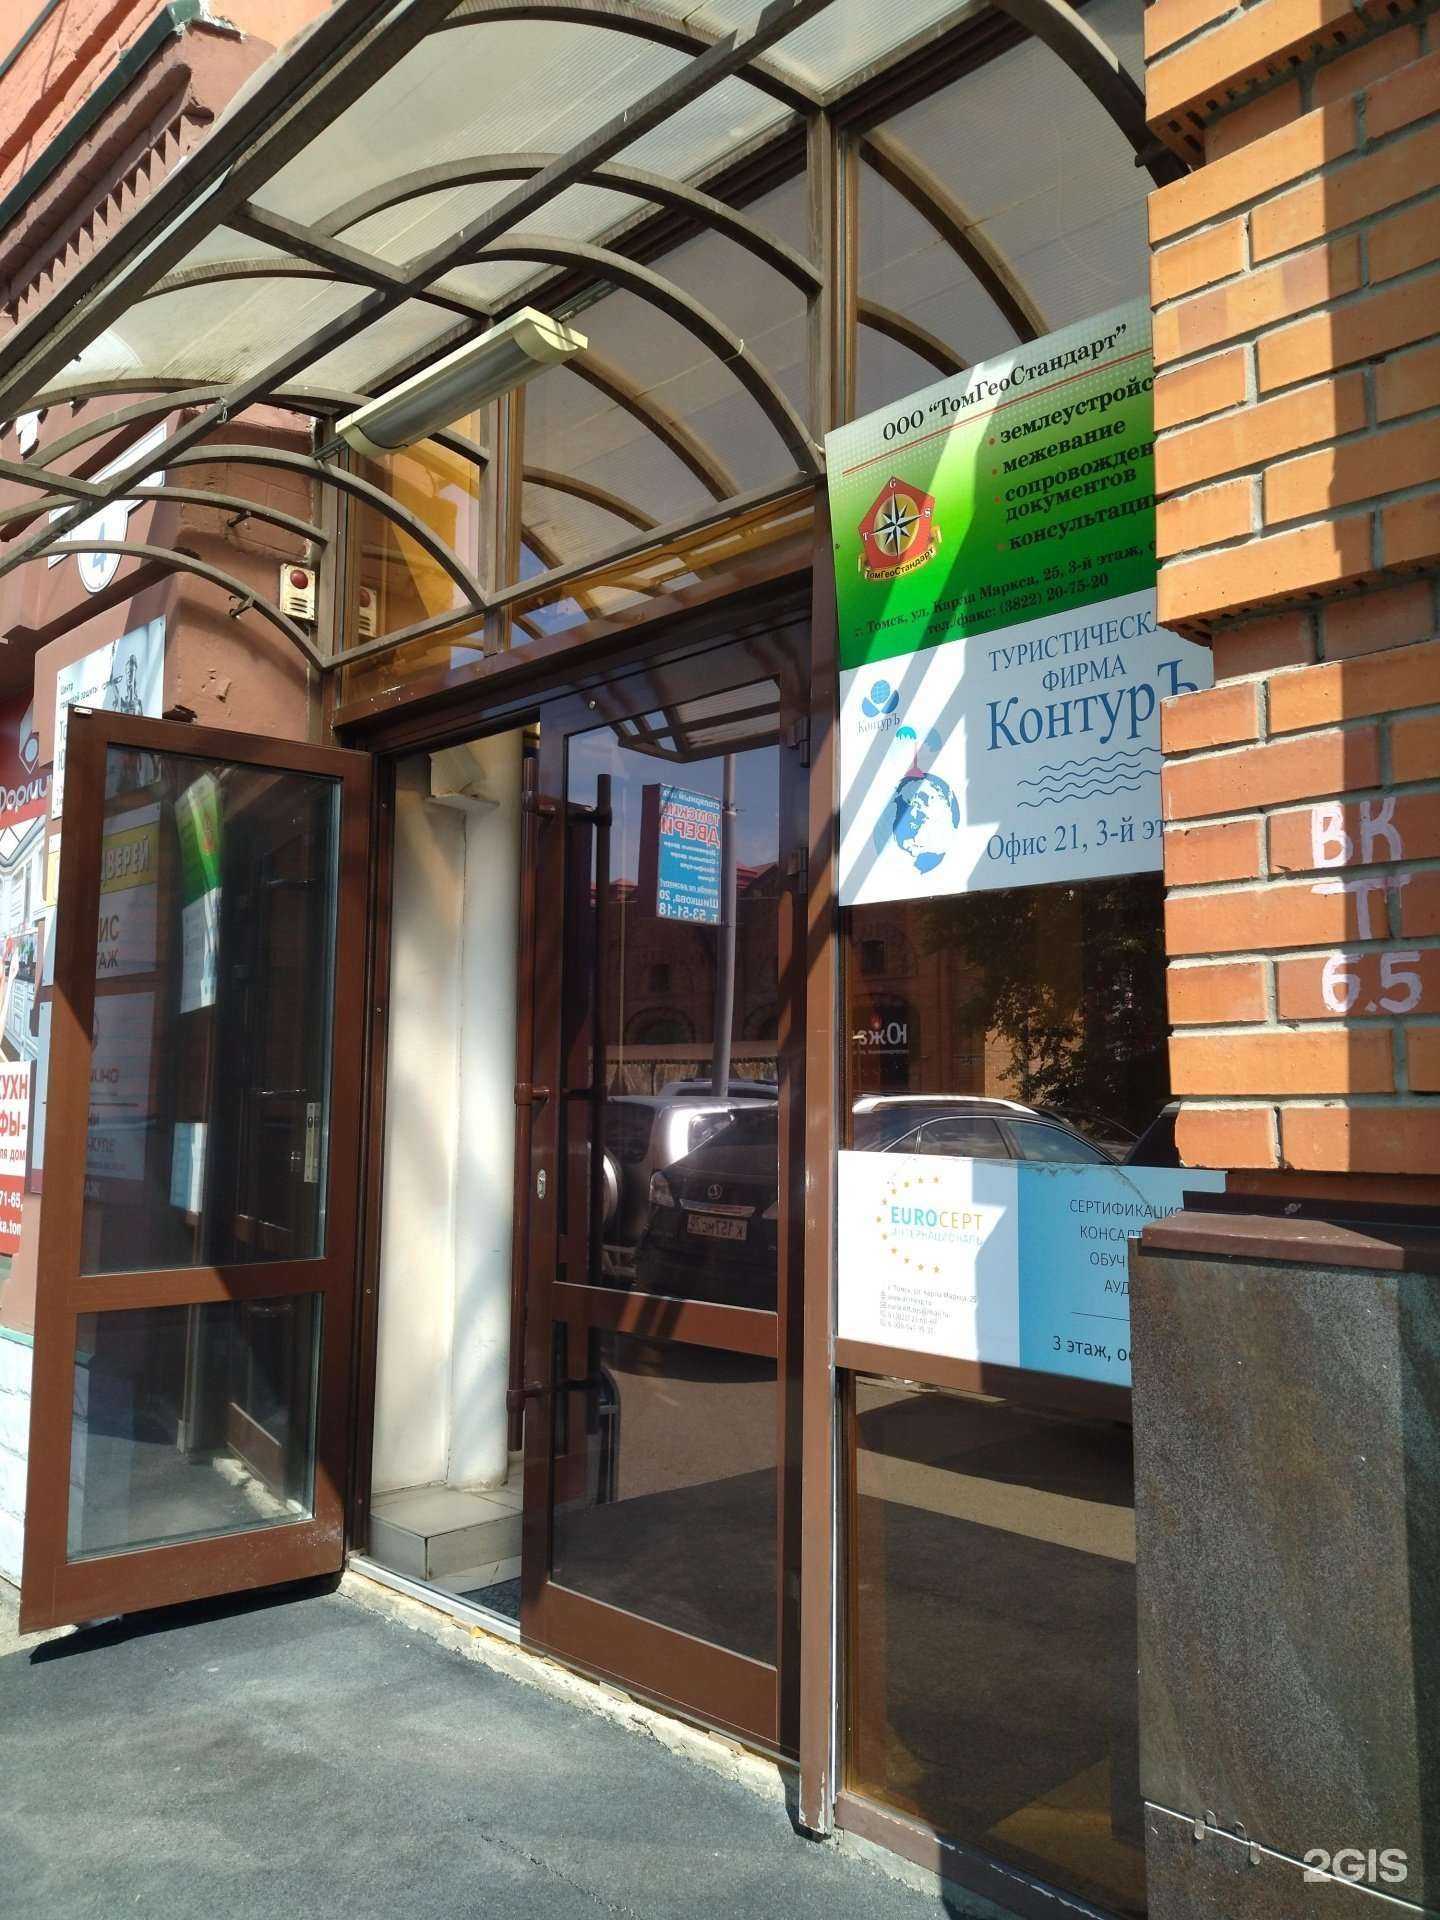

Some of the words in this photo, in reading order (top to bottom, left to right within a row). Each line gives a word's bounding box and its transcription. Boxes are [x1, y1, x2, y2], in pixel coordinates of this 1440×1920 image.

[883, 410, 925, 441] ООО
[1000, 375, 1156, 444] землеустройс
[1003, 420, 1127, 474] межевание
[1006, 468, 1137, 525] документов
[1047, 573, 1109, 602] 20-75-20
[988, 611, 1157, 672] ТУРИСТИЧЕСК
[1042, 653, 1128, 692] ФИРМА
[987, 831, 1048, 864] Офис
[1053, 824, 1088, 852] 21,
[1096, 816, 1134, 847] 3-й
[891, 1206, 984, 1231] EUROCEPT
[1089, 1251, 1125, 1269] ОБУЧ
[1053, 1336, 1061, 1351] 3
[1066, 1340, 1111, 1362] этаж,
